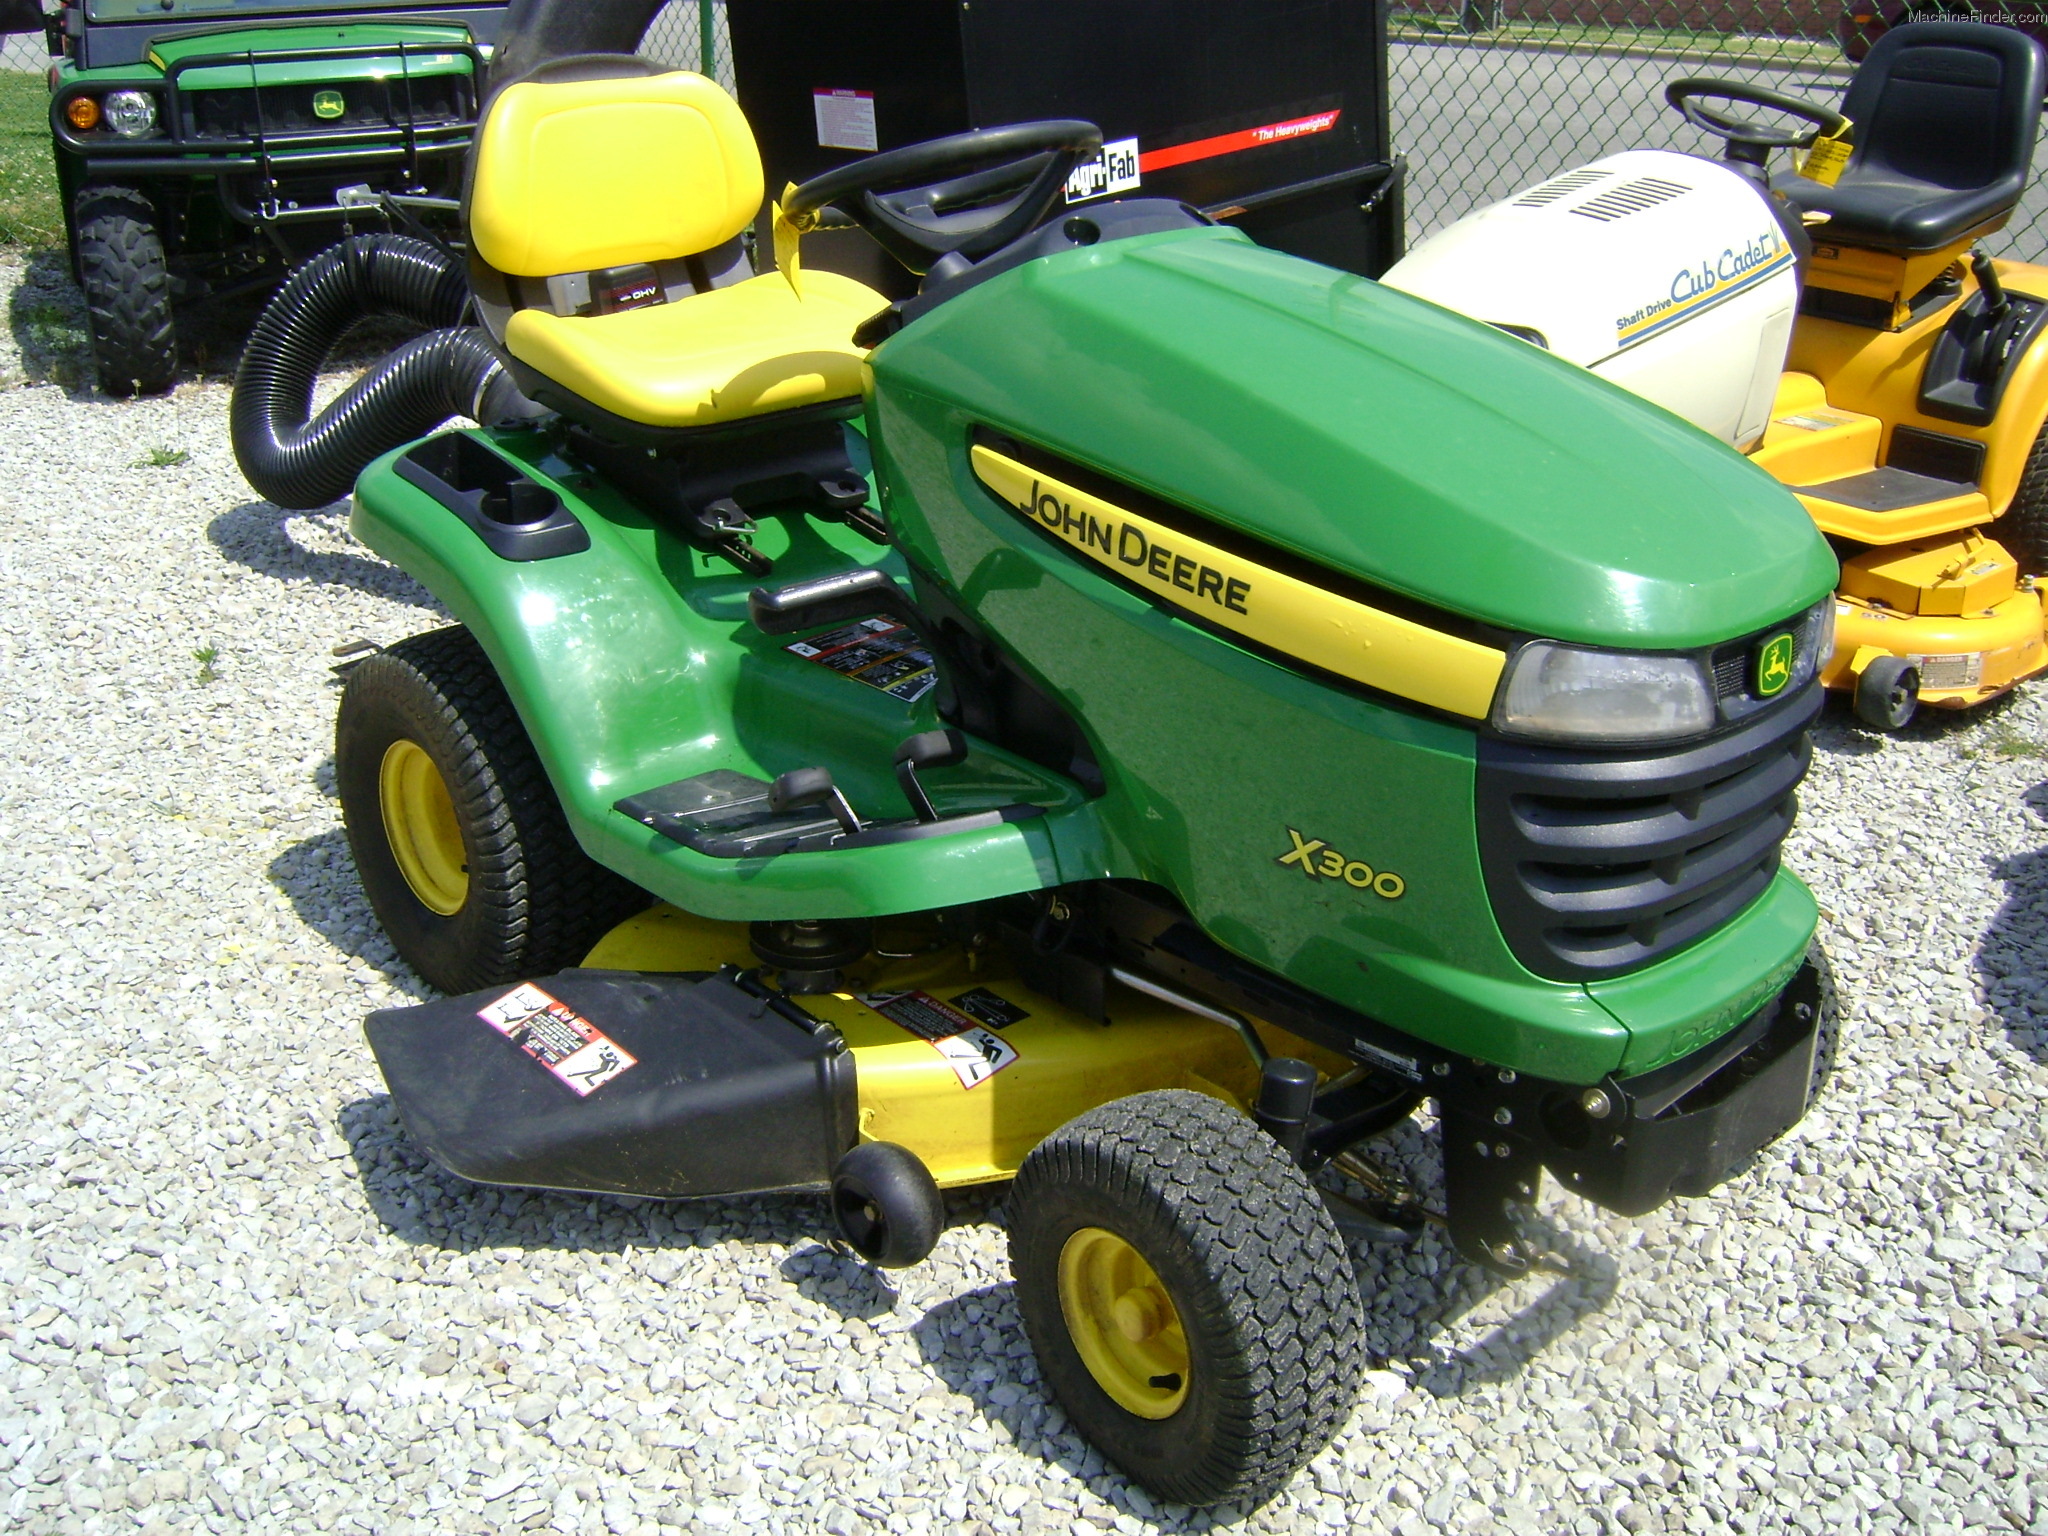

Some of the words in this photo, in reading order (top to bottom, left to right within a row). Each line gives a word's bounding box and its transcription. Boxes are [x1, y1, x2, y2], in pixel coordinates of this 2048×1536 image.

[1068, 149, 1135, 196] Agri-Fab
[1670, 261, 1716, 303] Cub
[1717, 234, 1773, 281] Cadet
[632, 286, 656, 300] OHV
[1616, 310, 1645, 330] Shaft
[1646, 299, 1672, 317] Drive
[1020, 479, 1113, 555] JOHN
[1118, 522, 1251, 616] DEERE
[1275, 825, 1406, 900] X300
[928, 999, 967, 1025] DANGER
